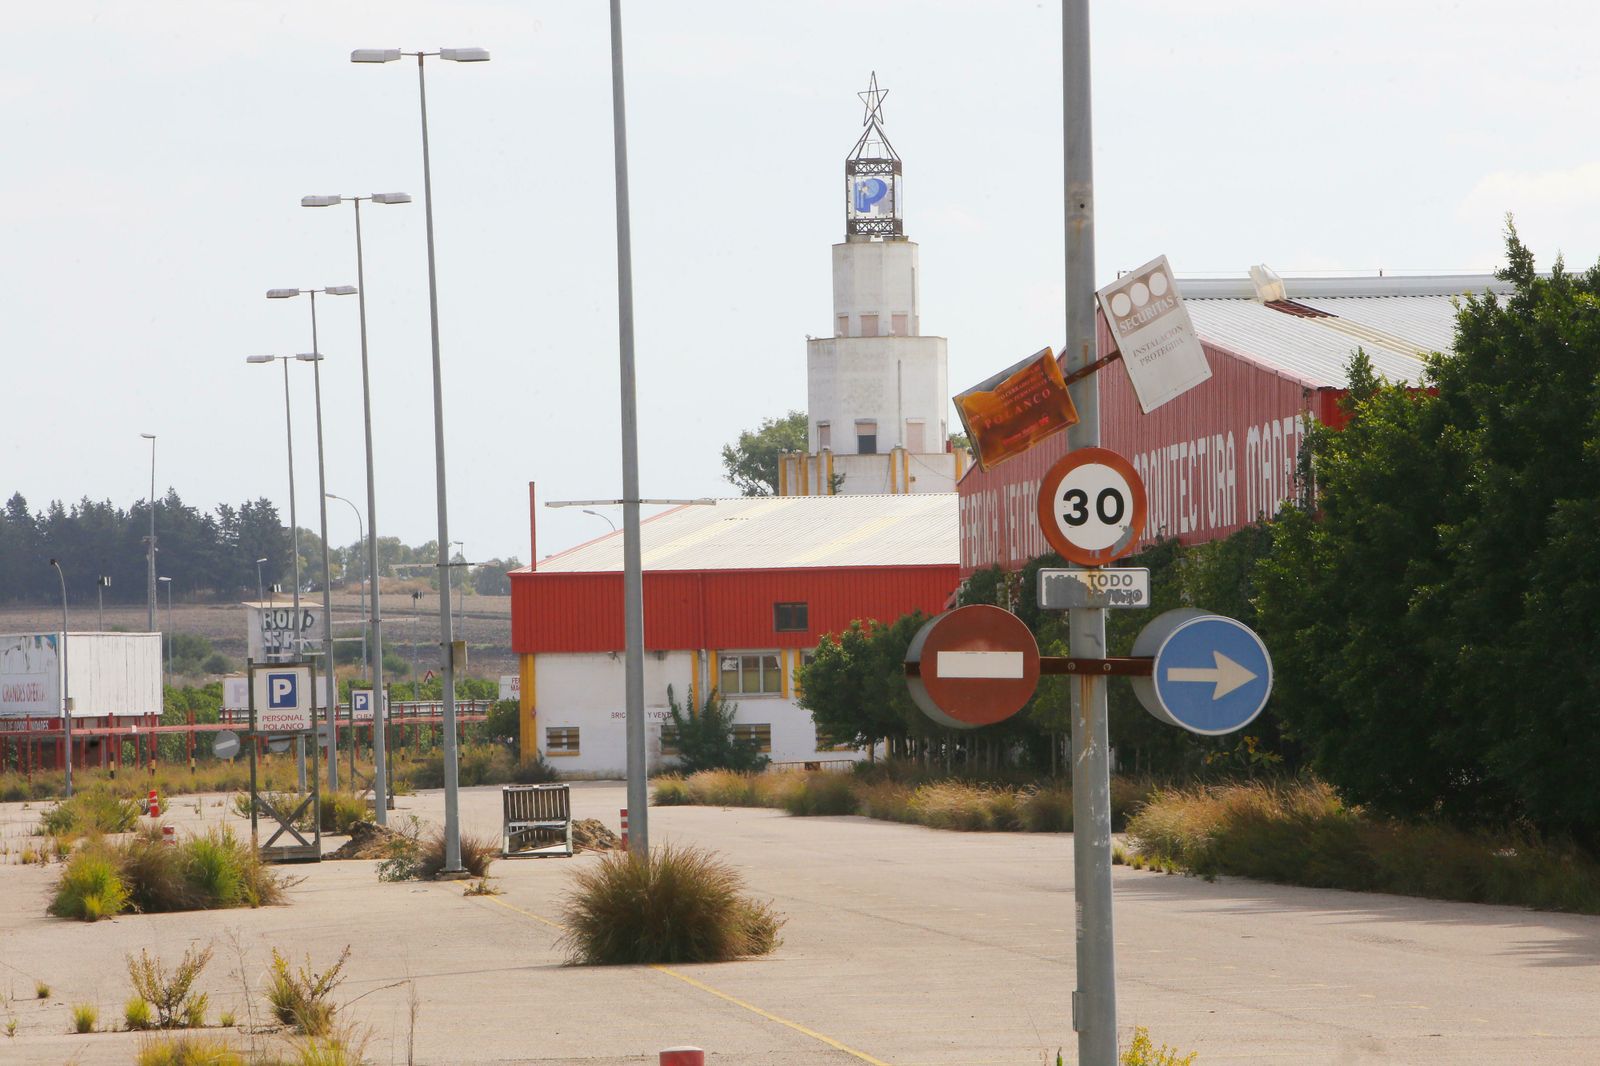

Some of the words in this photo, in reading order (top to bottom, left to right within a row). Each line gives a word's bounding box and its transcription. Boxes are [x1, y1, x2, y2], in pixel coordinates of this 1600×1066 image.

[1119, 294, 1175, 334] SECURITAS
[1139, 336, 1185, 367] PROTEGIDA
[983, 387, 1053, 430] POLANCO
[1063, 487, 1125, 526] 30
[960, 488, 999, 568] FABRICA
[1088, 574, 1133, 587] TODO
[272, 678, 292, 704] P
[356, 695, 367, 709] P
[262, 714, 304, 722] PERSONAL
[263, 722, 304, 731] POLANCO
